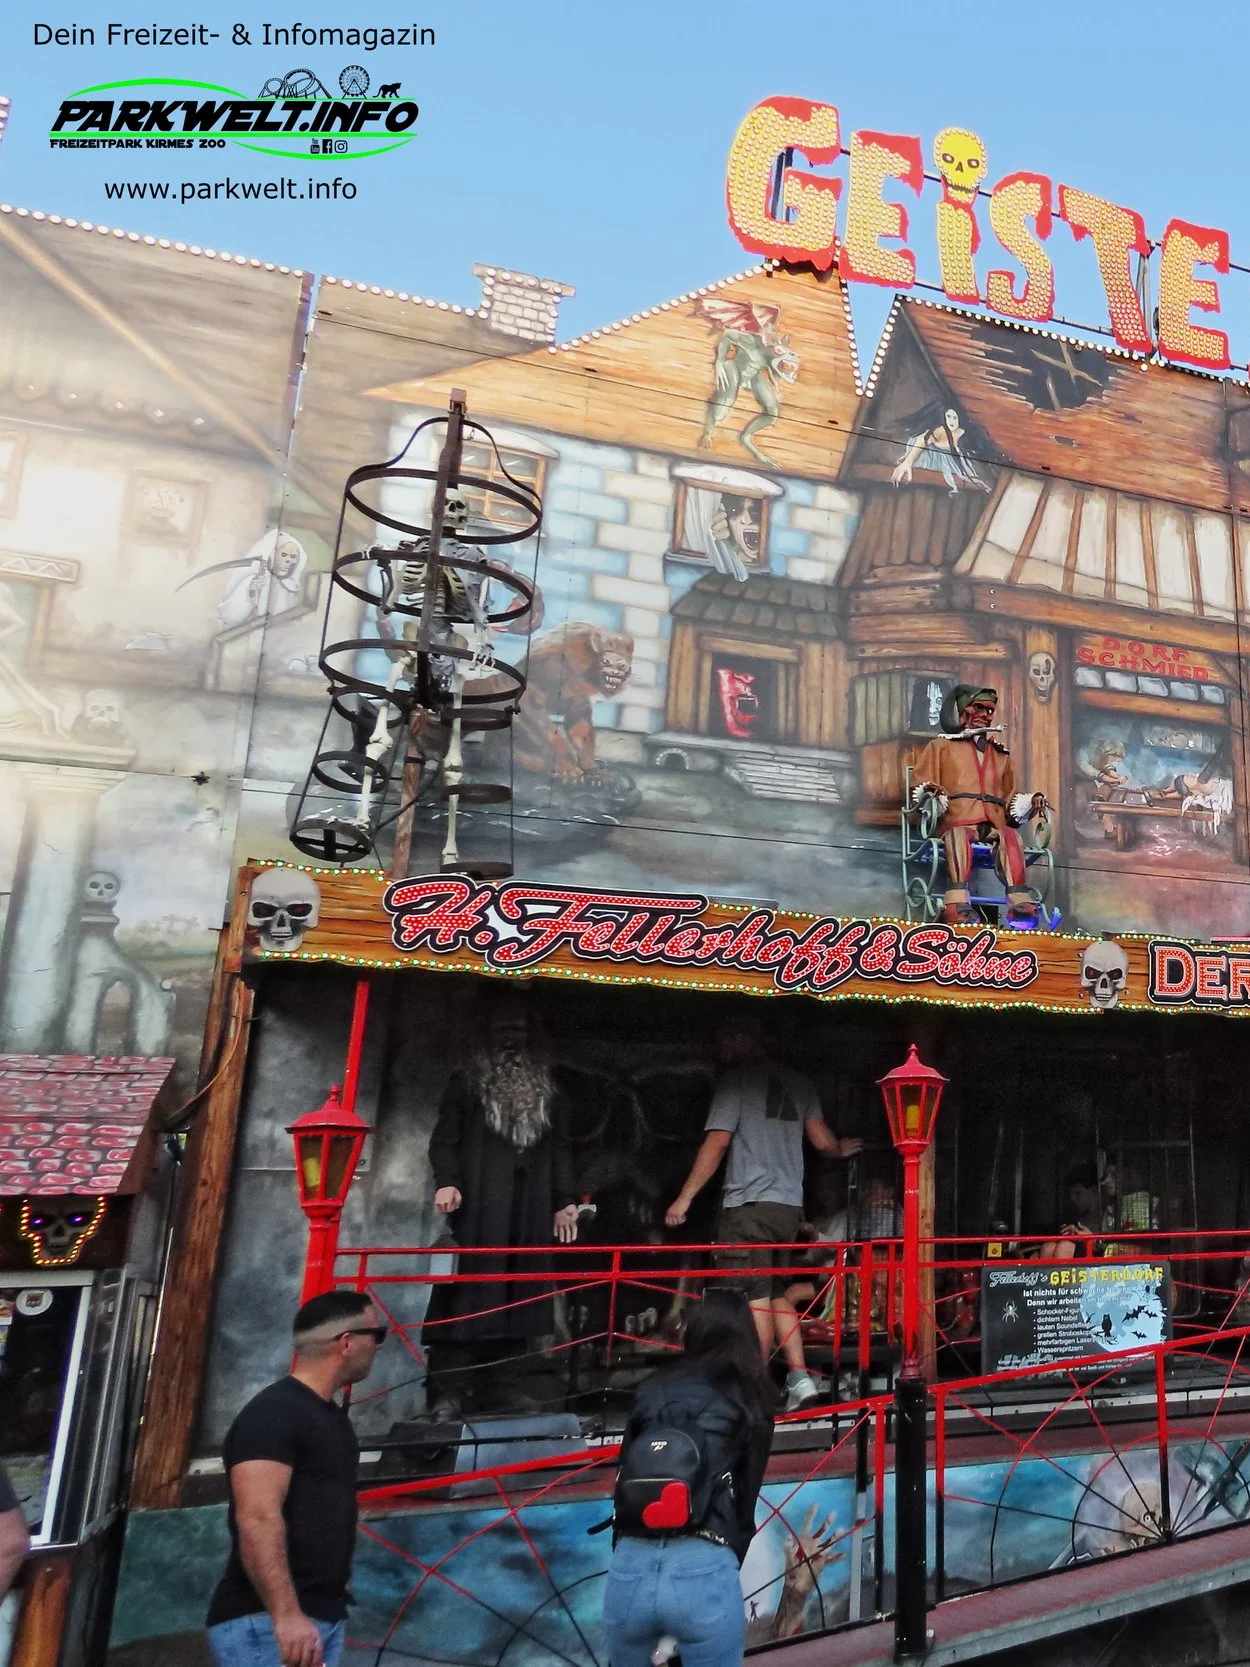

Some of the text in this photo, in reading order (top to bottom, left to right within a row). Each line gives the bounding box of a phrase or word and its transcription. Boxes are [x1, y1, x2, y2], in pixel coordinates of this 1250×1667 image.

[1102, 636, 1190, 663] DORF
[1077, 646, 1209, 681] SCHMIED
[390, 880, 1035, 985] H. Fellerhoff & Söhne
[1023, 1289, 1033, 1297] Ist
[1034, 1288, 1057, 1297] nichts
[1058, 1287, 1069, 1296] für
[1027, 1299, 1046, 1307] Denn
[1047, 1298, 1057, 1306] wir
